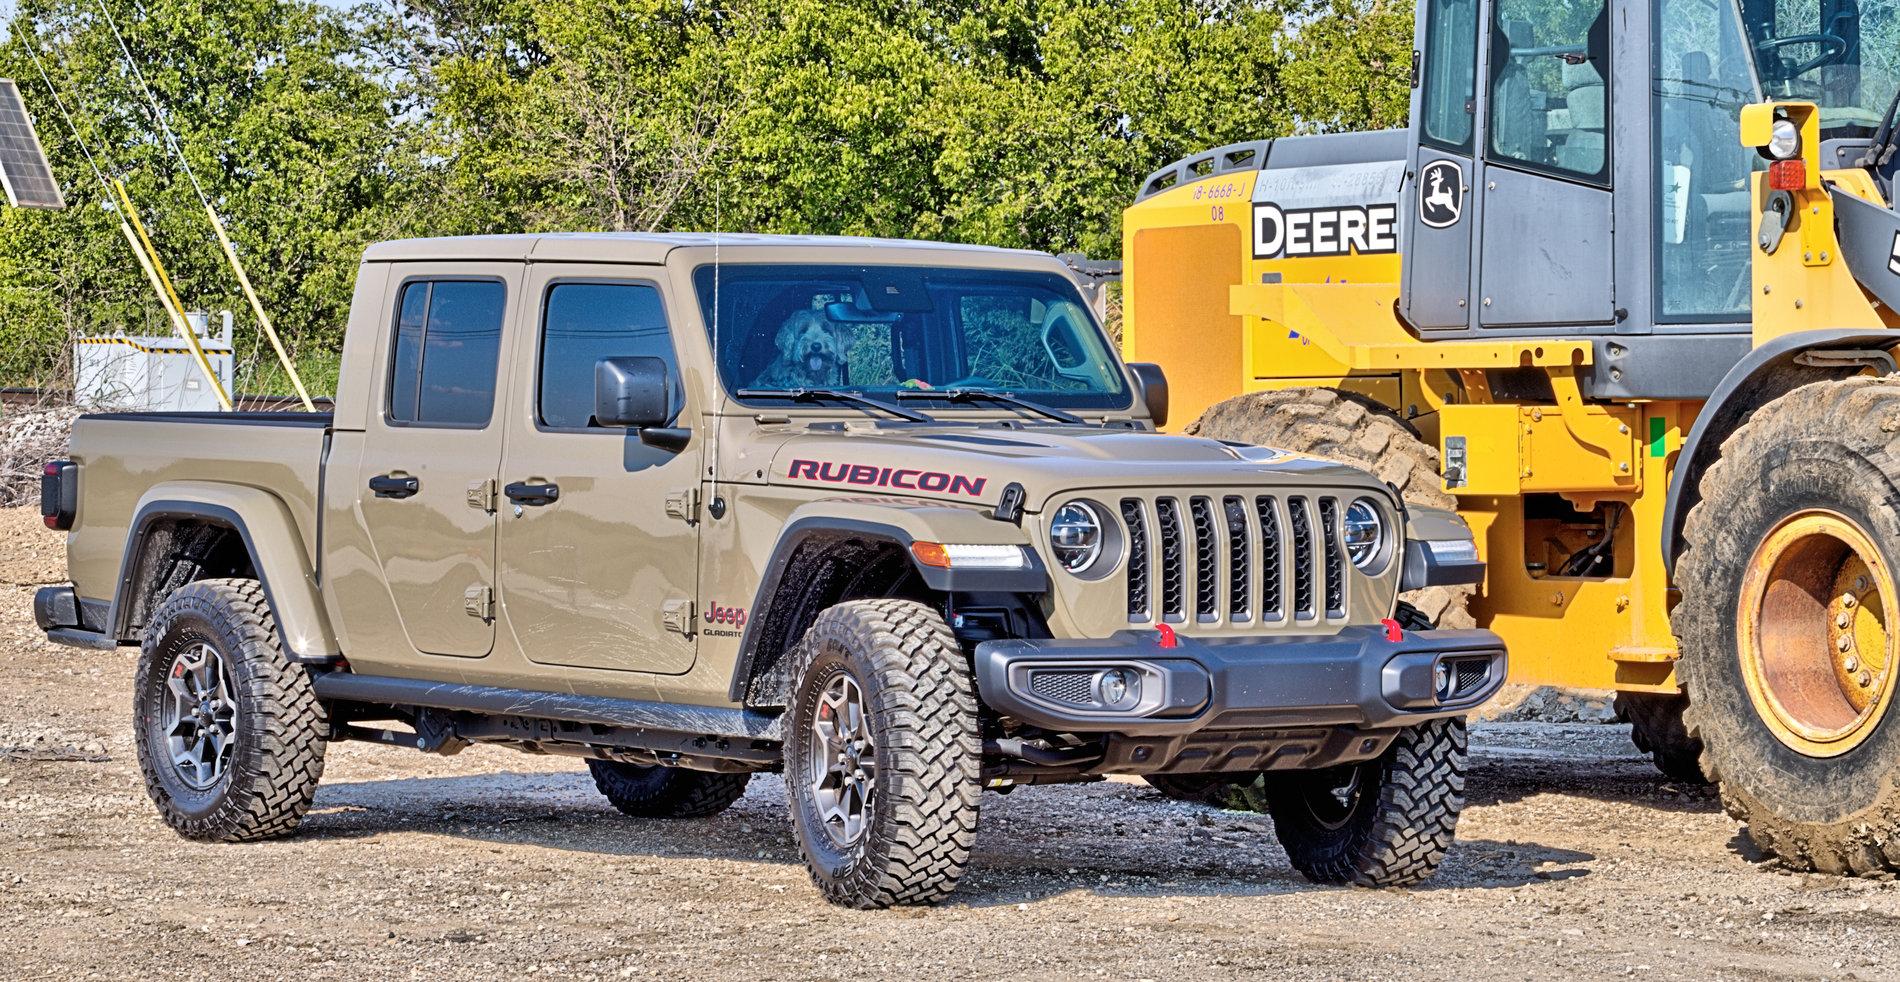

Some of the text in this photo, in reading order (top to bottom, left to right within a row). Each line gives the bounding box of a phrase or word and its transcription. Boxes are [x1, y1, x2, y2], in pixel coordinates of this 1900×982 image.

[1211, 205, 1224, 221] 08
[1253, 203, 1396, 257] DEERE
[788, 459, 987, 496] RUBICON
[704, 600, 748, 629] Jeep
[703, 628, 742, 638] GLADIATO
